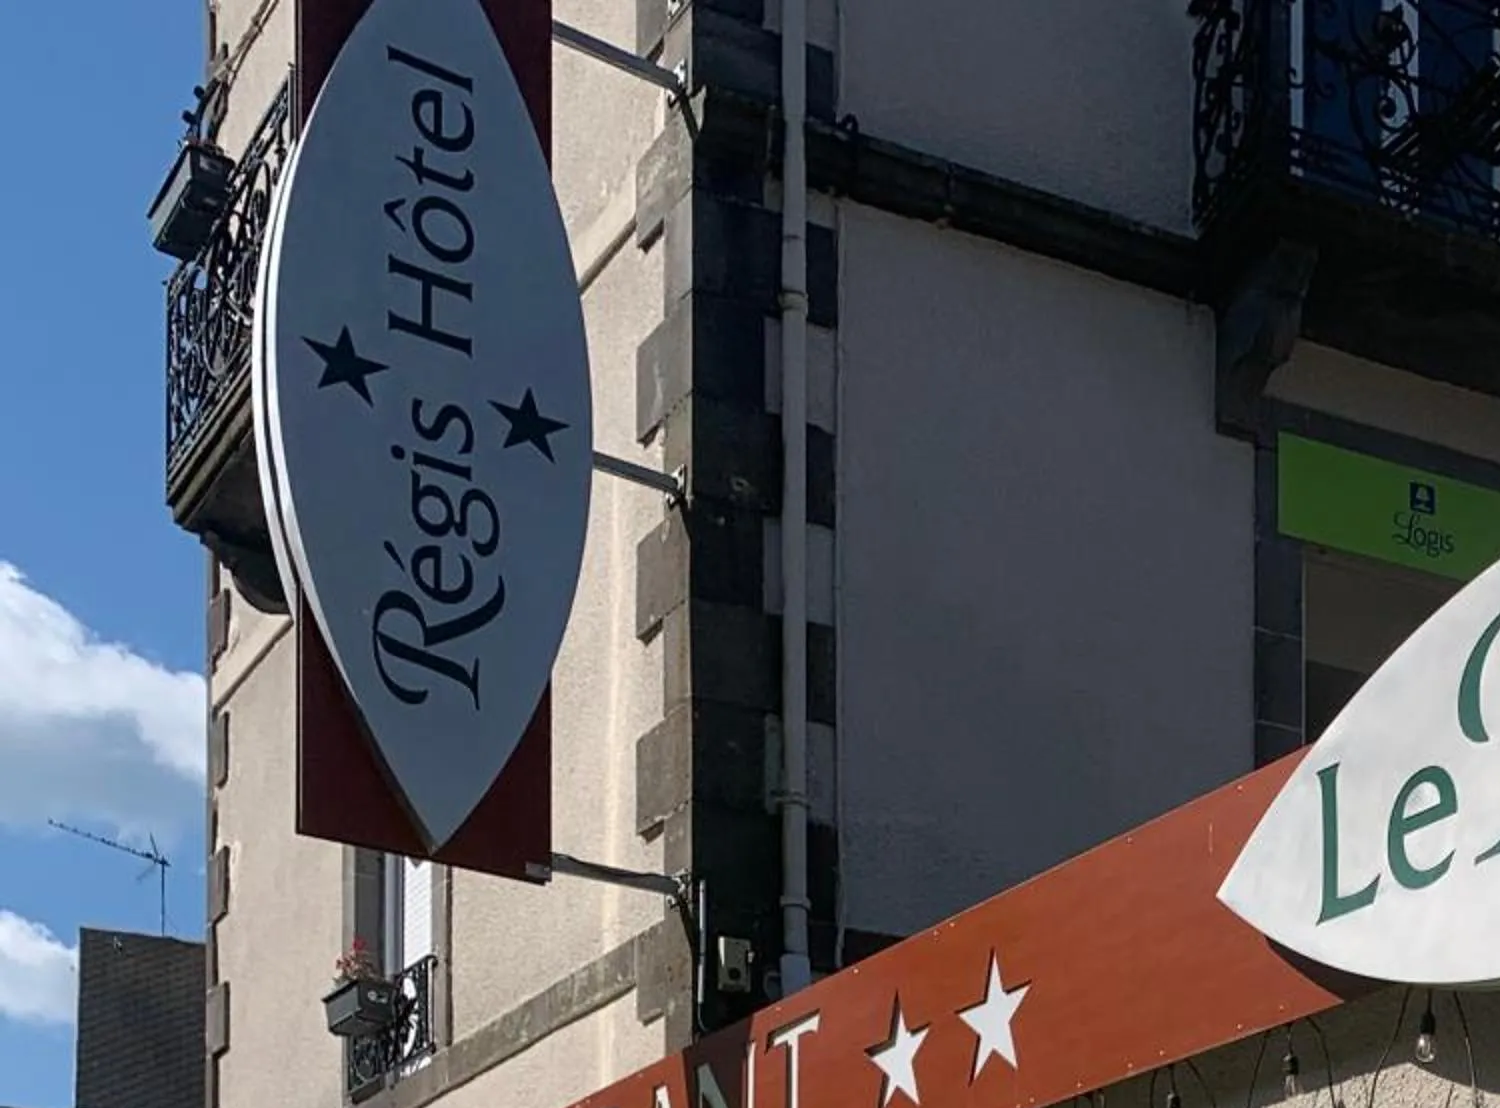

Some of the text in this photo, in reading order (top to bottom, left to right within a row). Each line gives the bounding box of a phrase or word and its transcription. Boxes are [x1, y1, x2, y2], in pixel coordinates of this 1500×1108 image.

[372, 45, 505, 710] Régis Hôtel
[1391, 511, 1455, 558] Logis
[1316, 762, 1458, 924] Le
